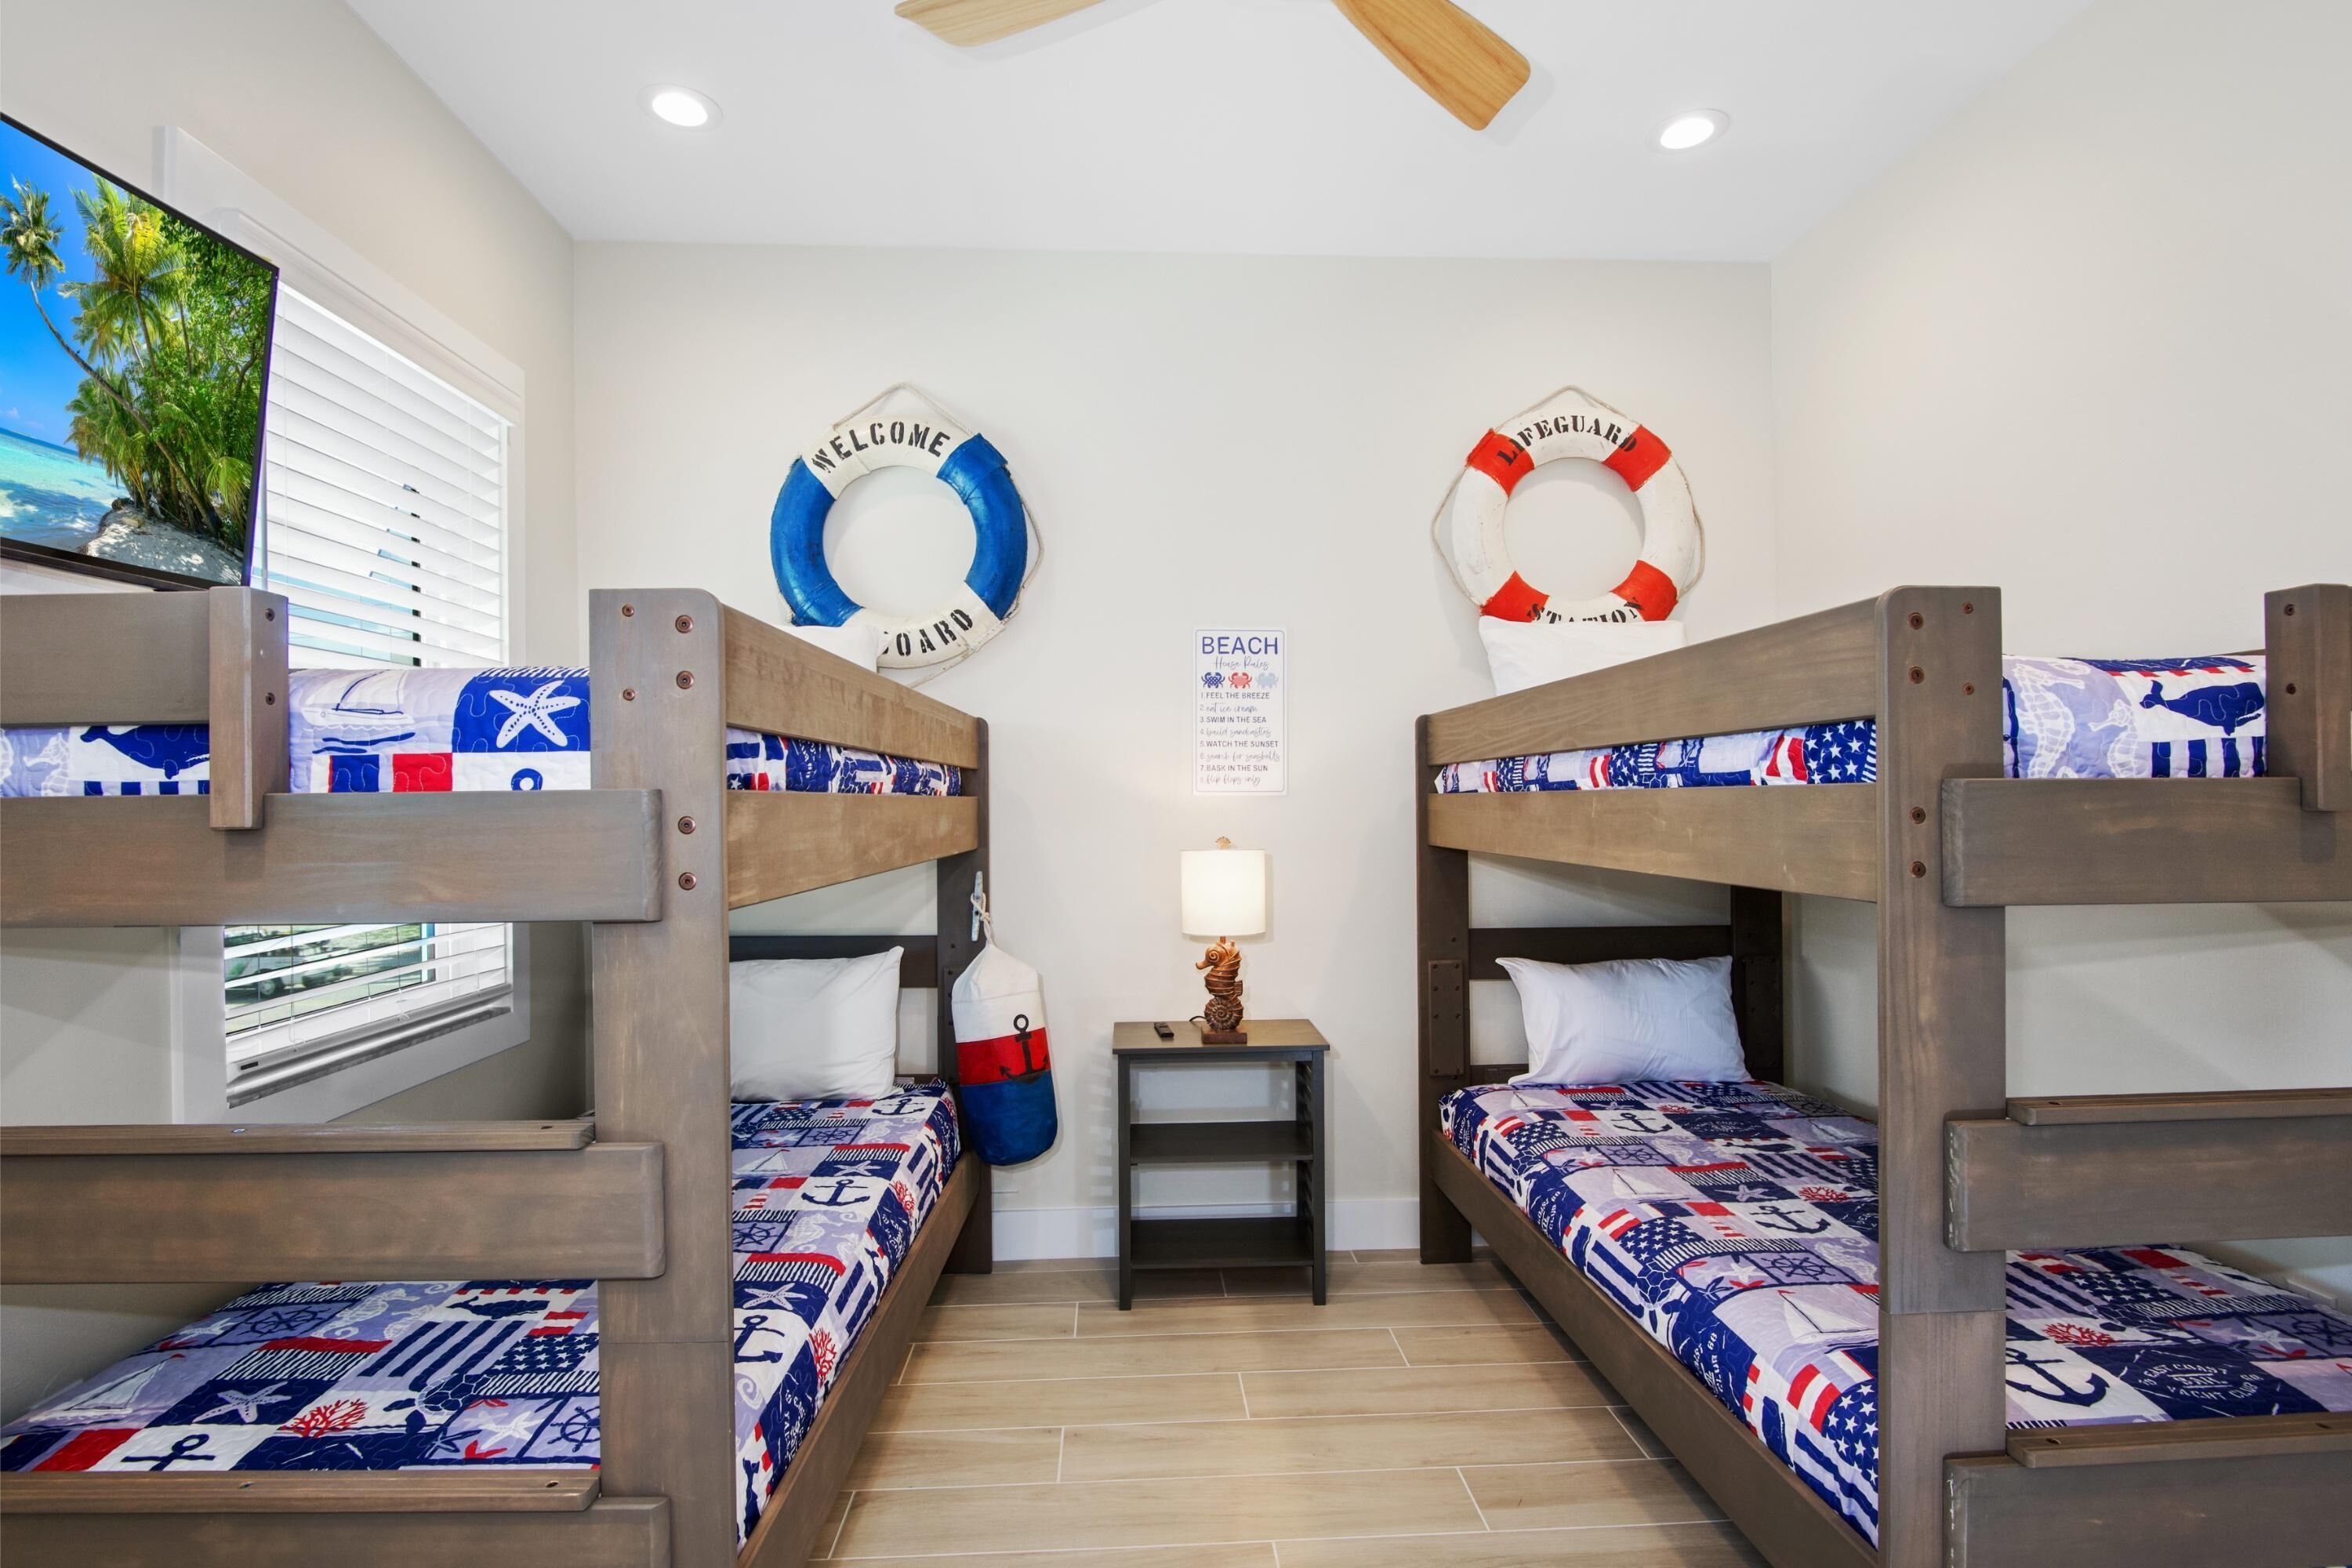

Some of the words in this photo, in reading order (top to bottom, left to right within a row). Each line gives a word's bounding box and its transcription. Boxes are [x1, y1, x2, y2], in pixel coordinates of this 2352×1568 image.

[811, 421, 950, 473] WELCOME
[1497, 415, 1637, 466] LIFEGUARD
[883, 609, 973, 656] OARD
[1202, 636, 1278, 655] BEACH
[1214, 655, 1241, 670] House
[1243, 655, 1269, 670] Rules
